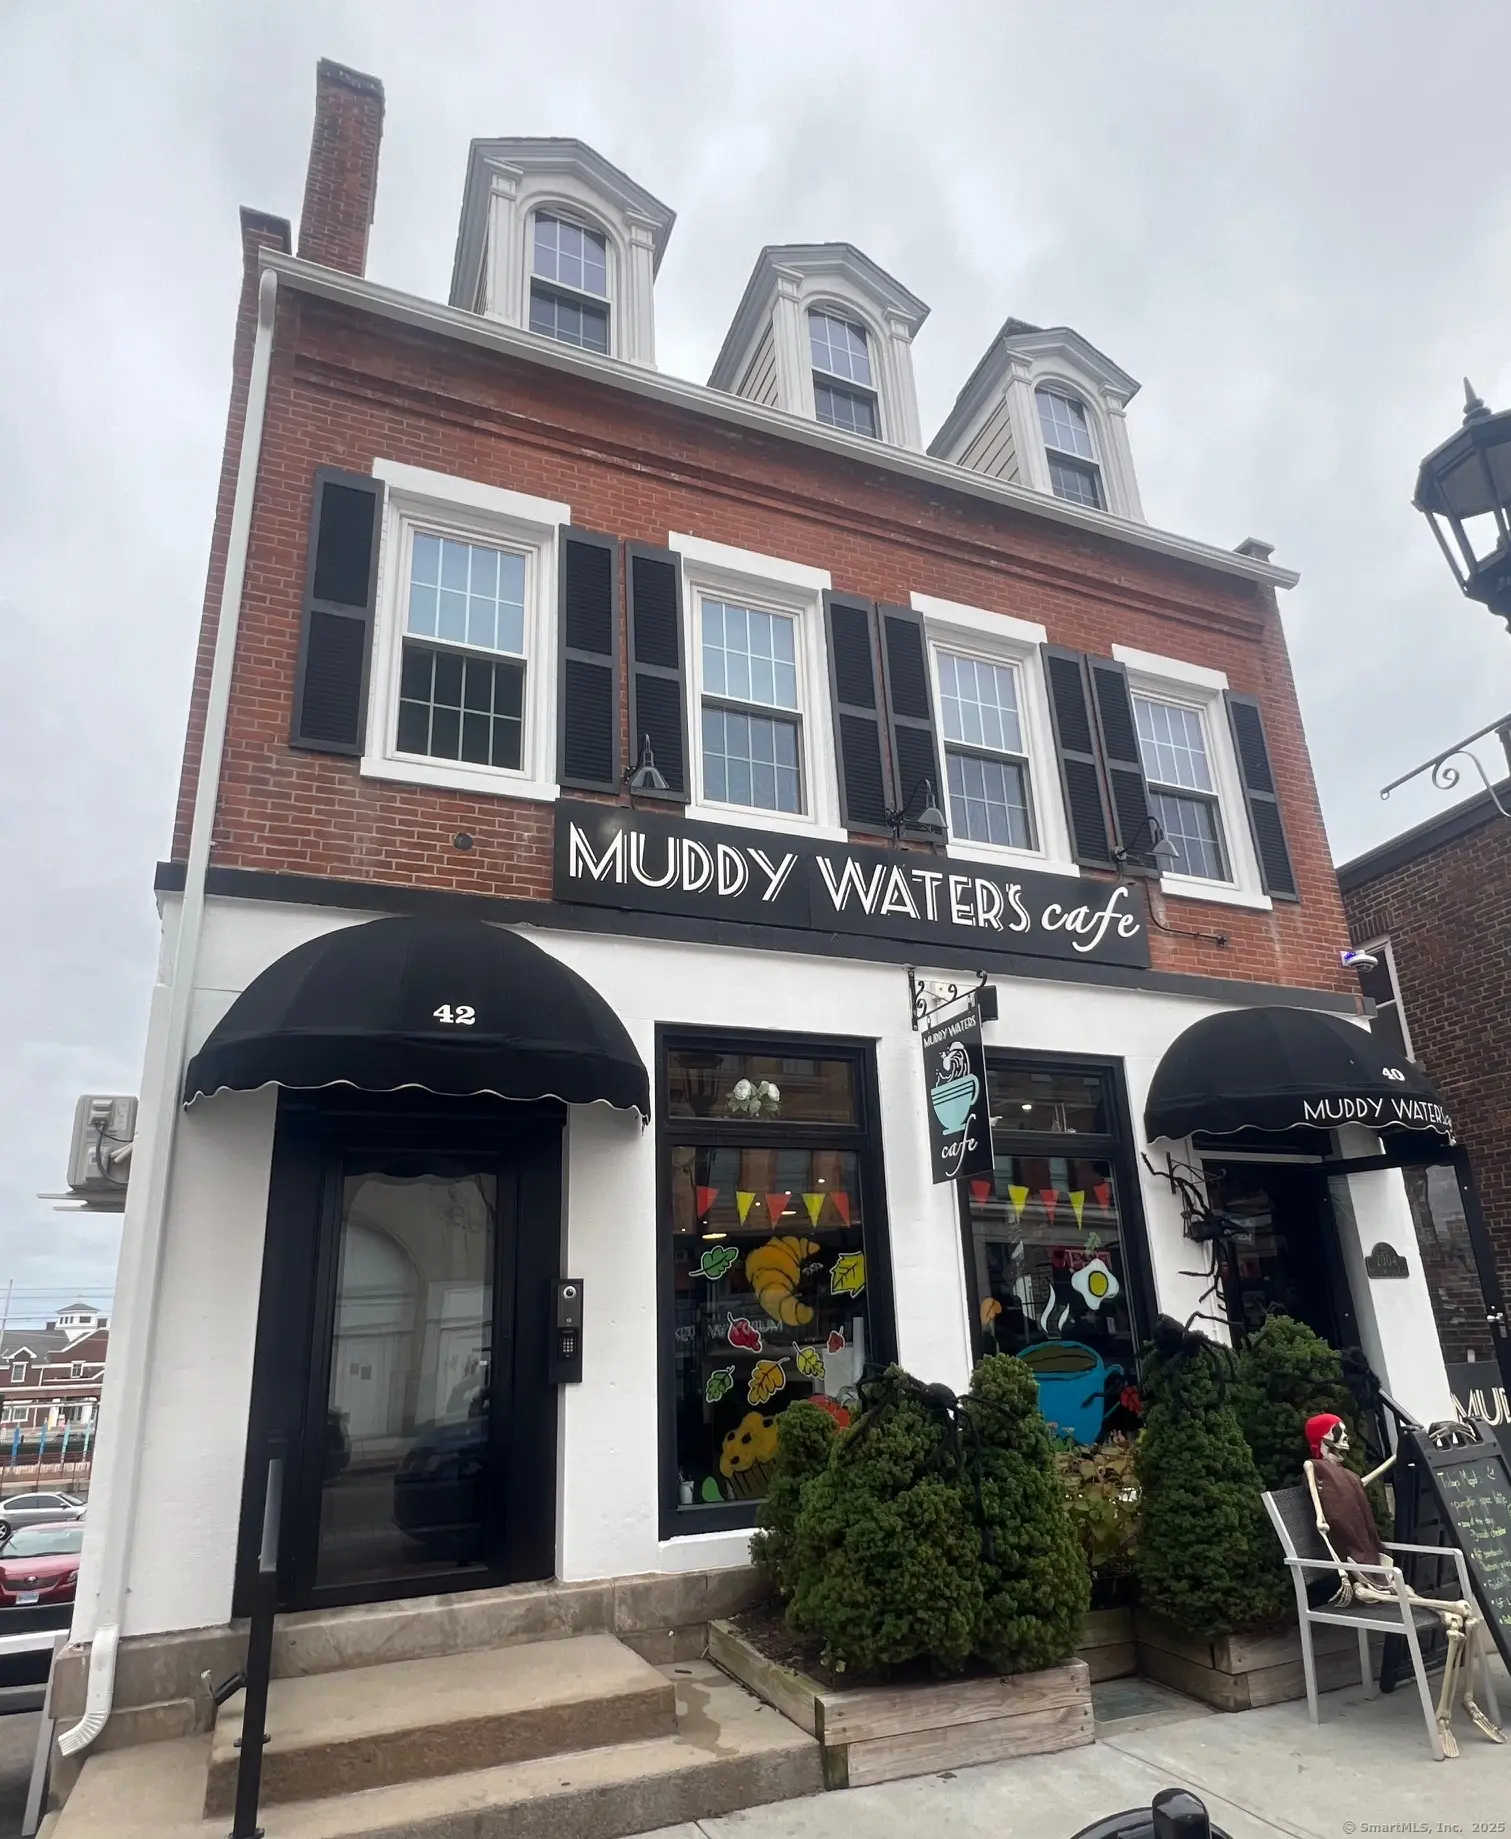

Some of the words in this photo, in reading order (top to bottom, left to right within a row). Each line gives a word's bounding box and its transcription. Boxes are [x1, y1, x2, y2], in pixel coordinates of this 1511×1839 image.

[569, 821, 798, 903] MUDDY
[1041, 885, 1140, 954] cafe
[432, 1004, 476, 1026] 42
[923, 1027, 948, 1048] MUDDY
[1382, 1067, 1405, 1081] 40
[1303, 1098, 1383, 1120] MUDDY
[941, 1113, 979, 1177] cafe
